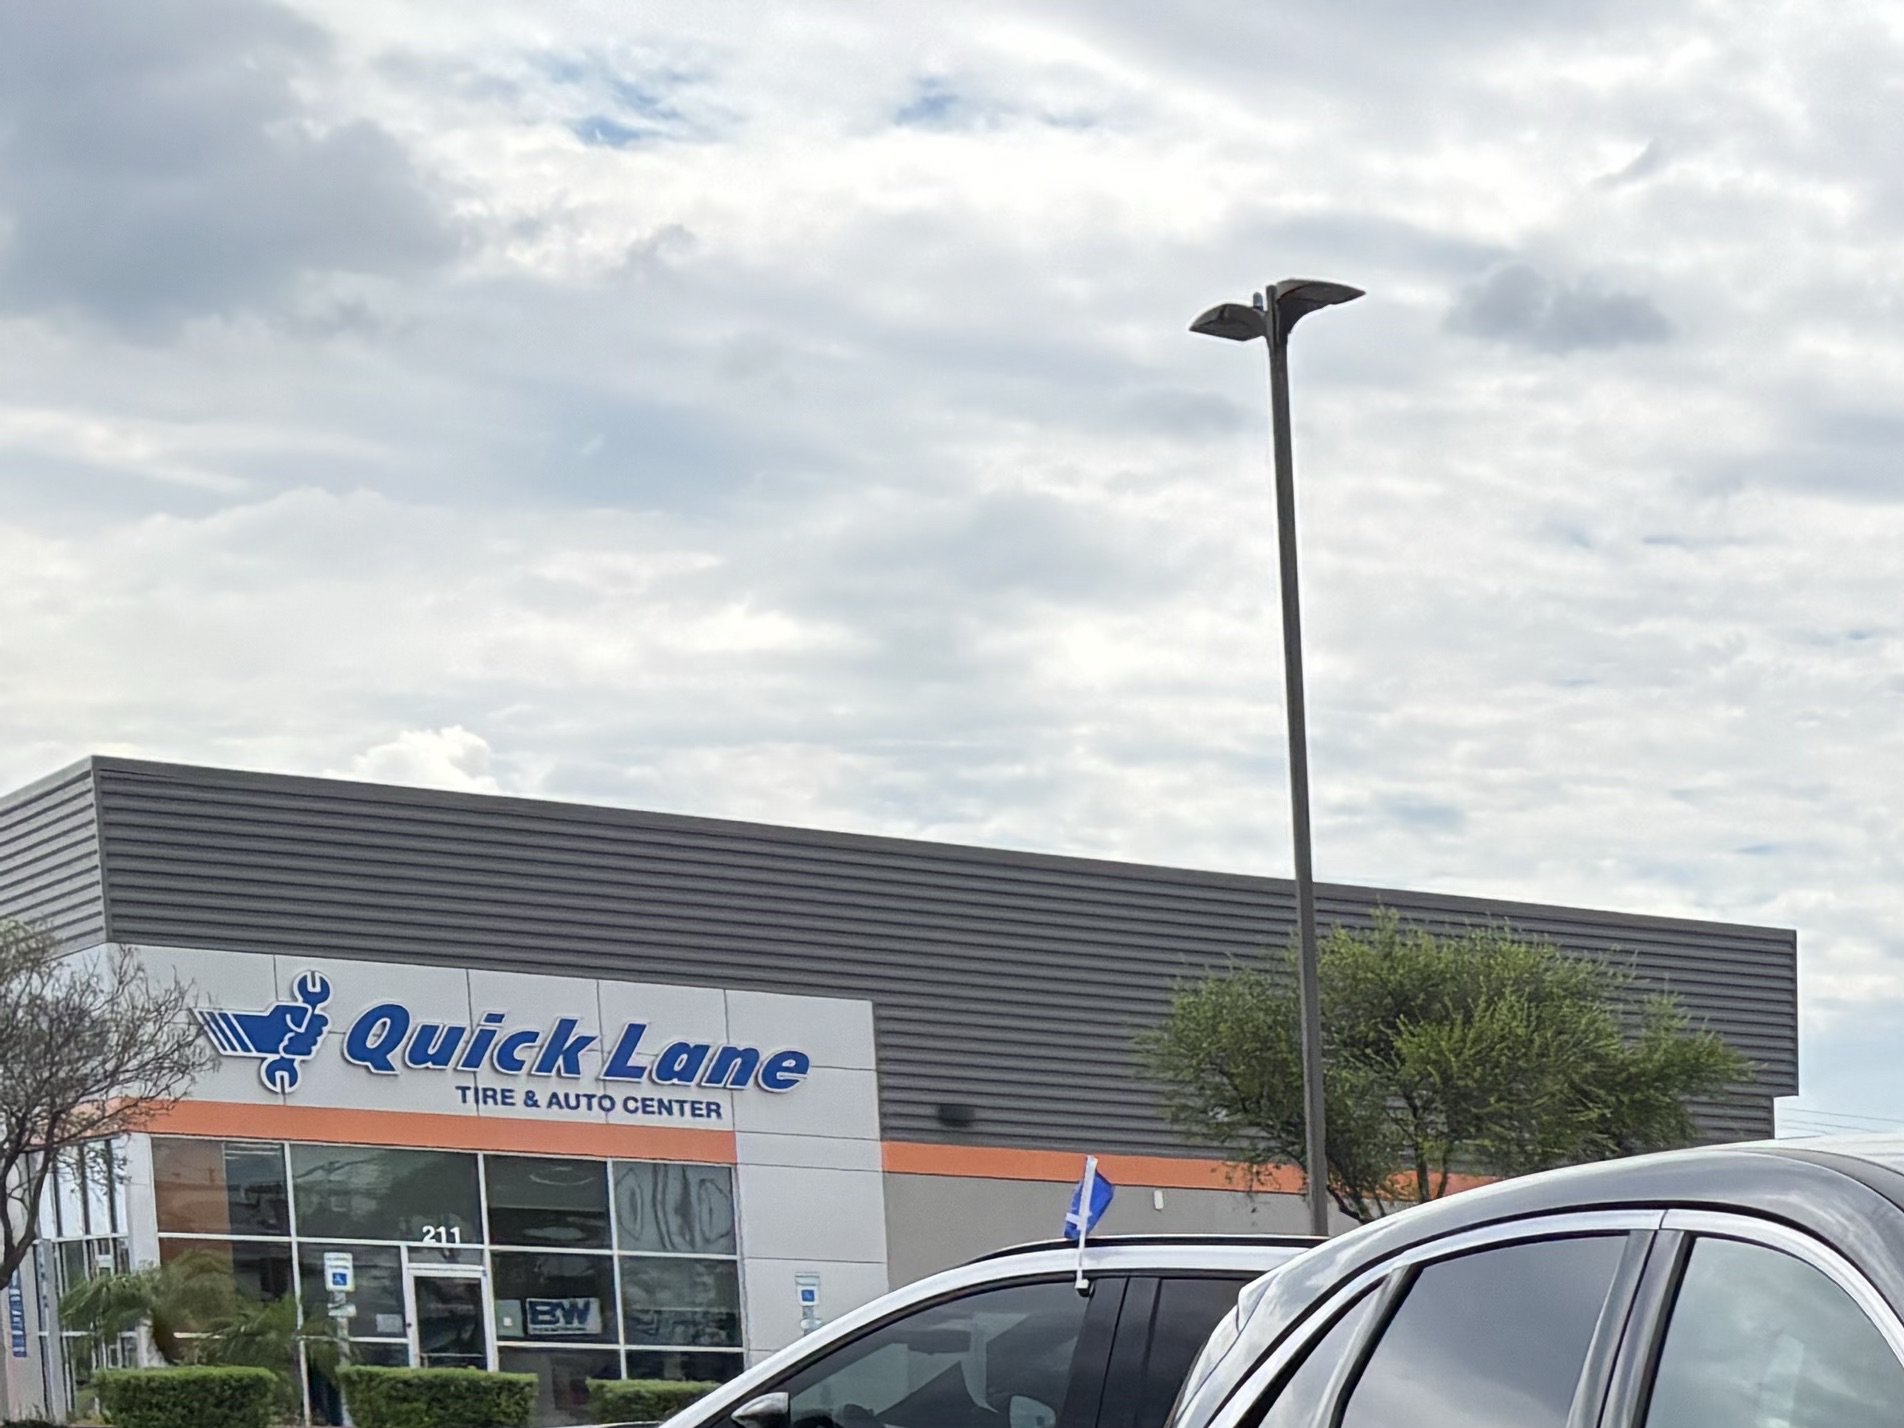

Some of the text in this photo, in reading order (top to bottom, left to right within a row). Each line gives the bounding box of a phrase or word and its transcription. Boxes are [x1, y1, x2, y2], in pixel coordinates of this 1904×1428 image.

[344, 1002, 811, 1093] Quick Lane
[455, 1085, 723, 1119] TIRE & AUTO CENTER
[422, 1225, 461, 1243] 211
